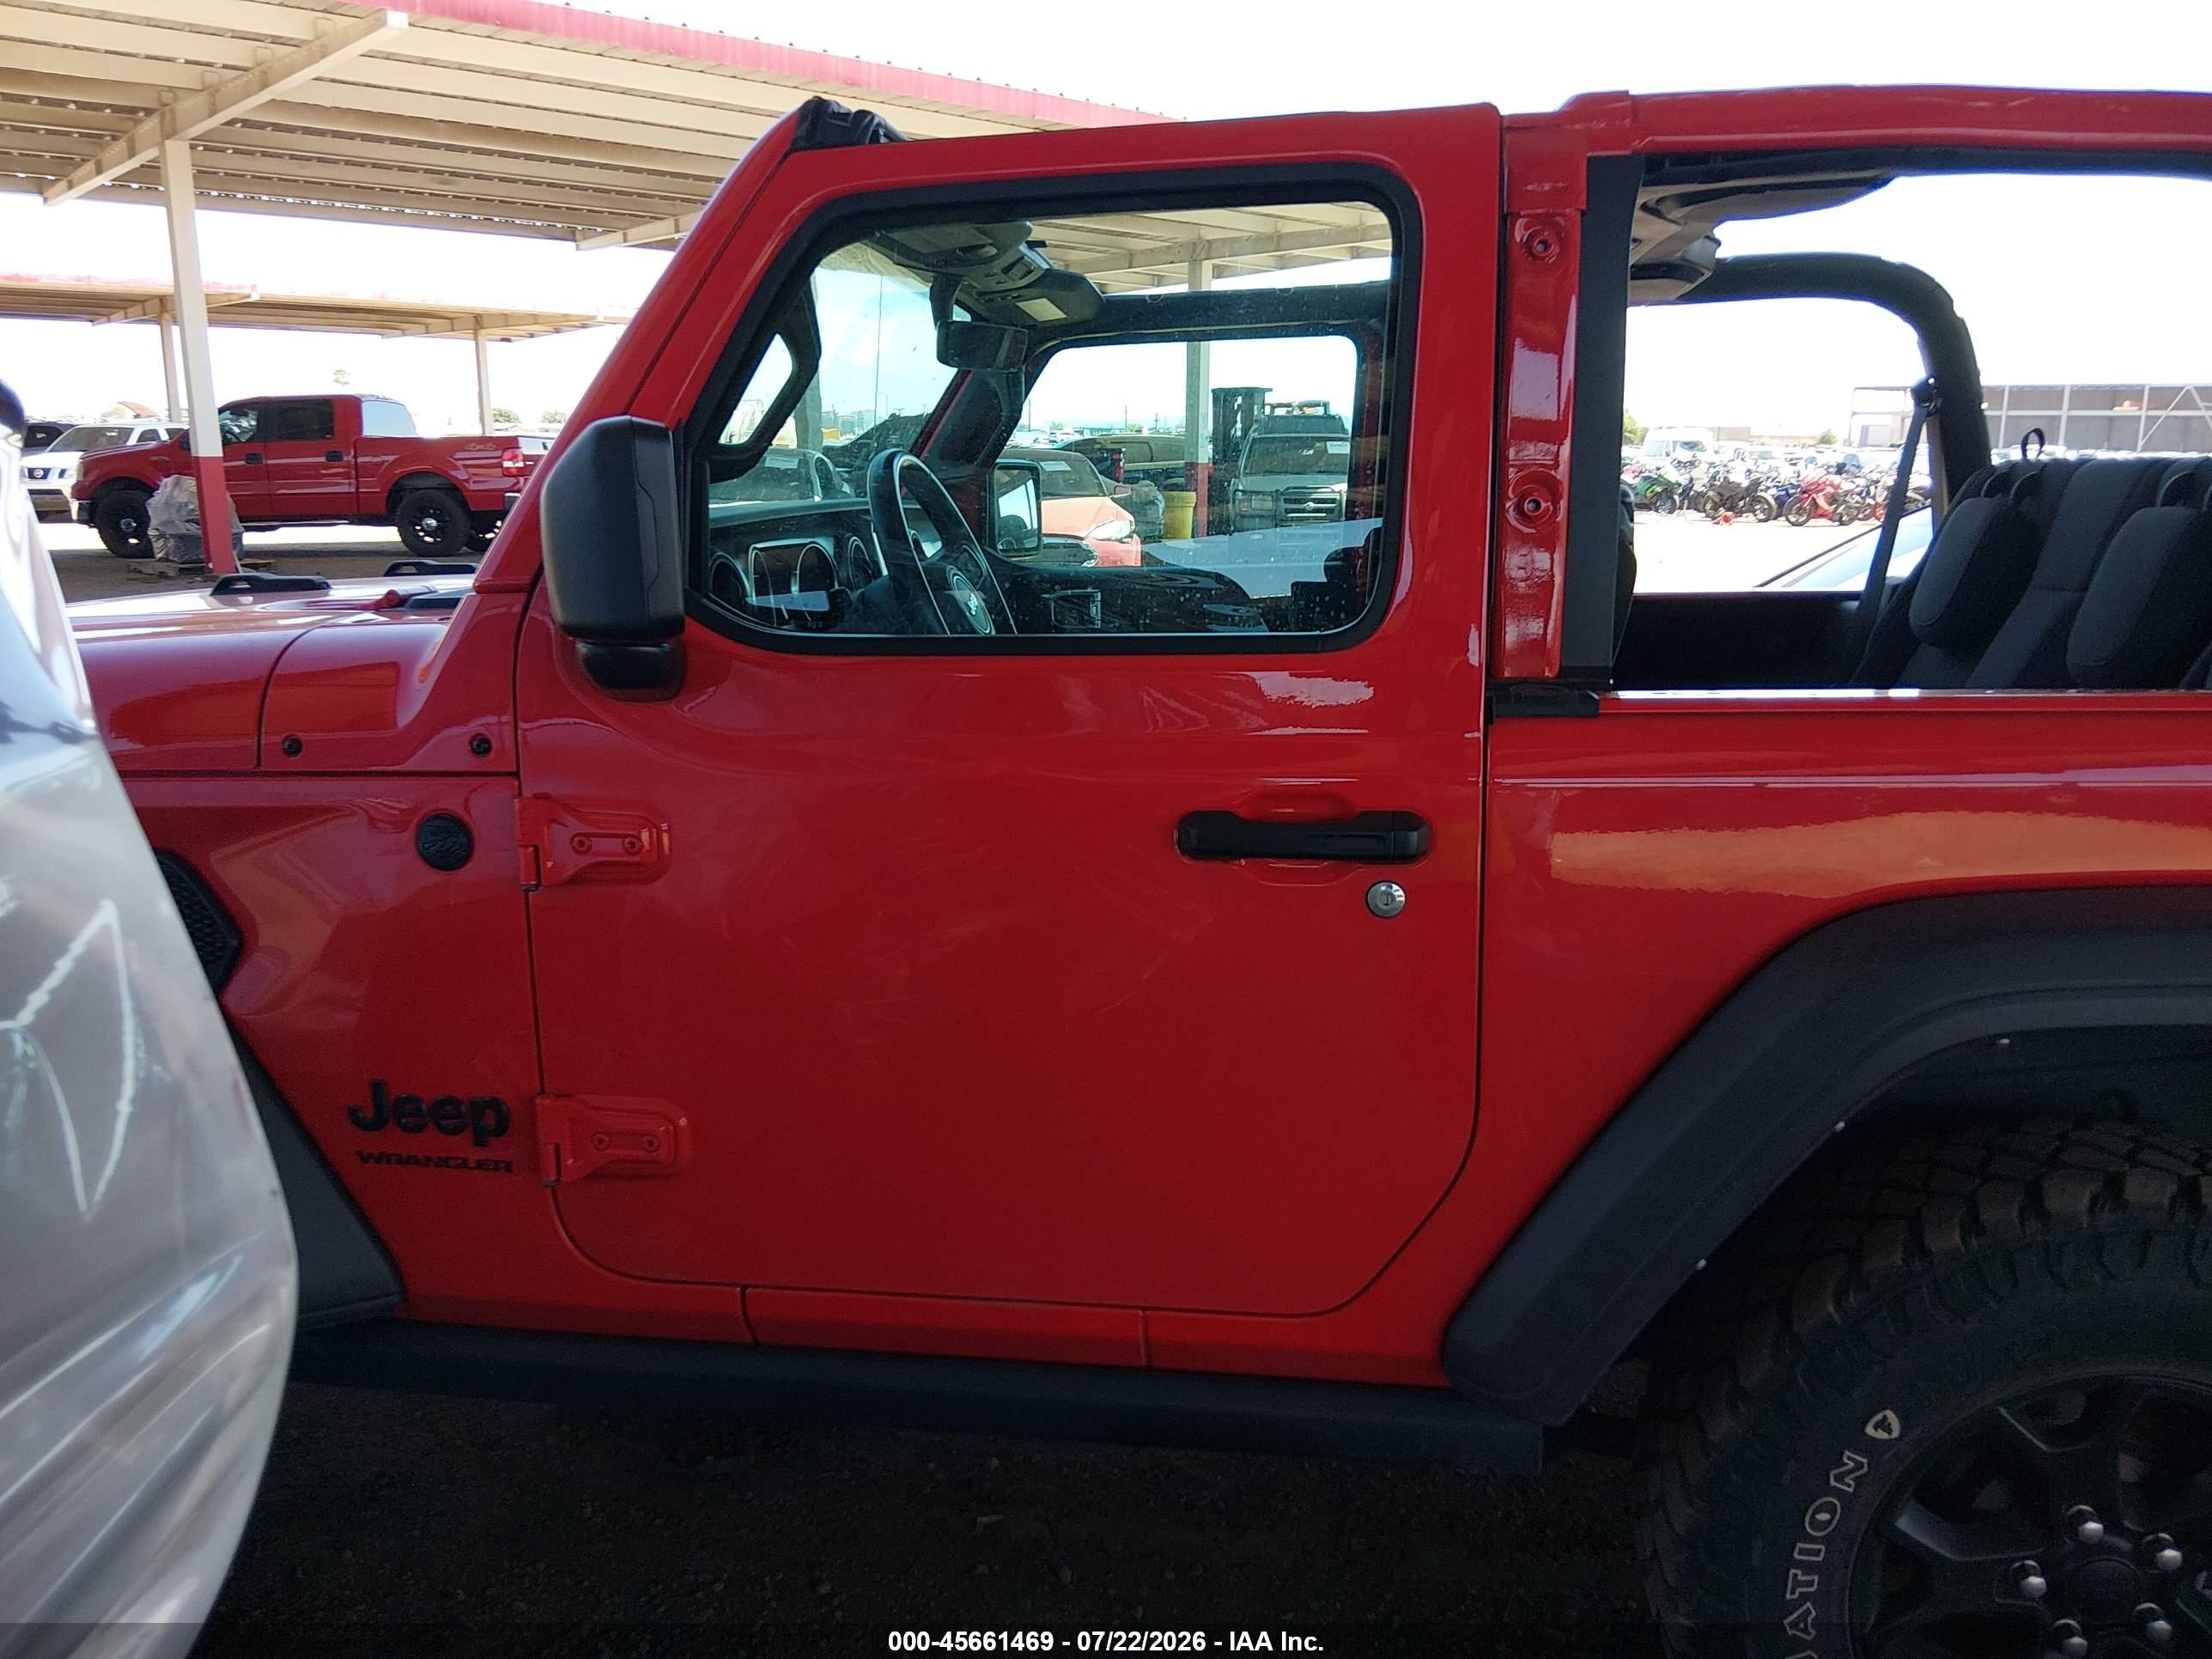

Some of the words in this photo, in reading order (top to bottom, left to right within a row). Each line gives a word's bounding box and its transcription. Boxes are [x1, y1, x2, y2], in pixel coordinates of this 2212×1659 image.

[348, 1079, 510, 1147] Jeep
[356, 1150, 514, 1173] WRANGLER
[1784, 1449, 1869, 1659] ATION
